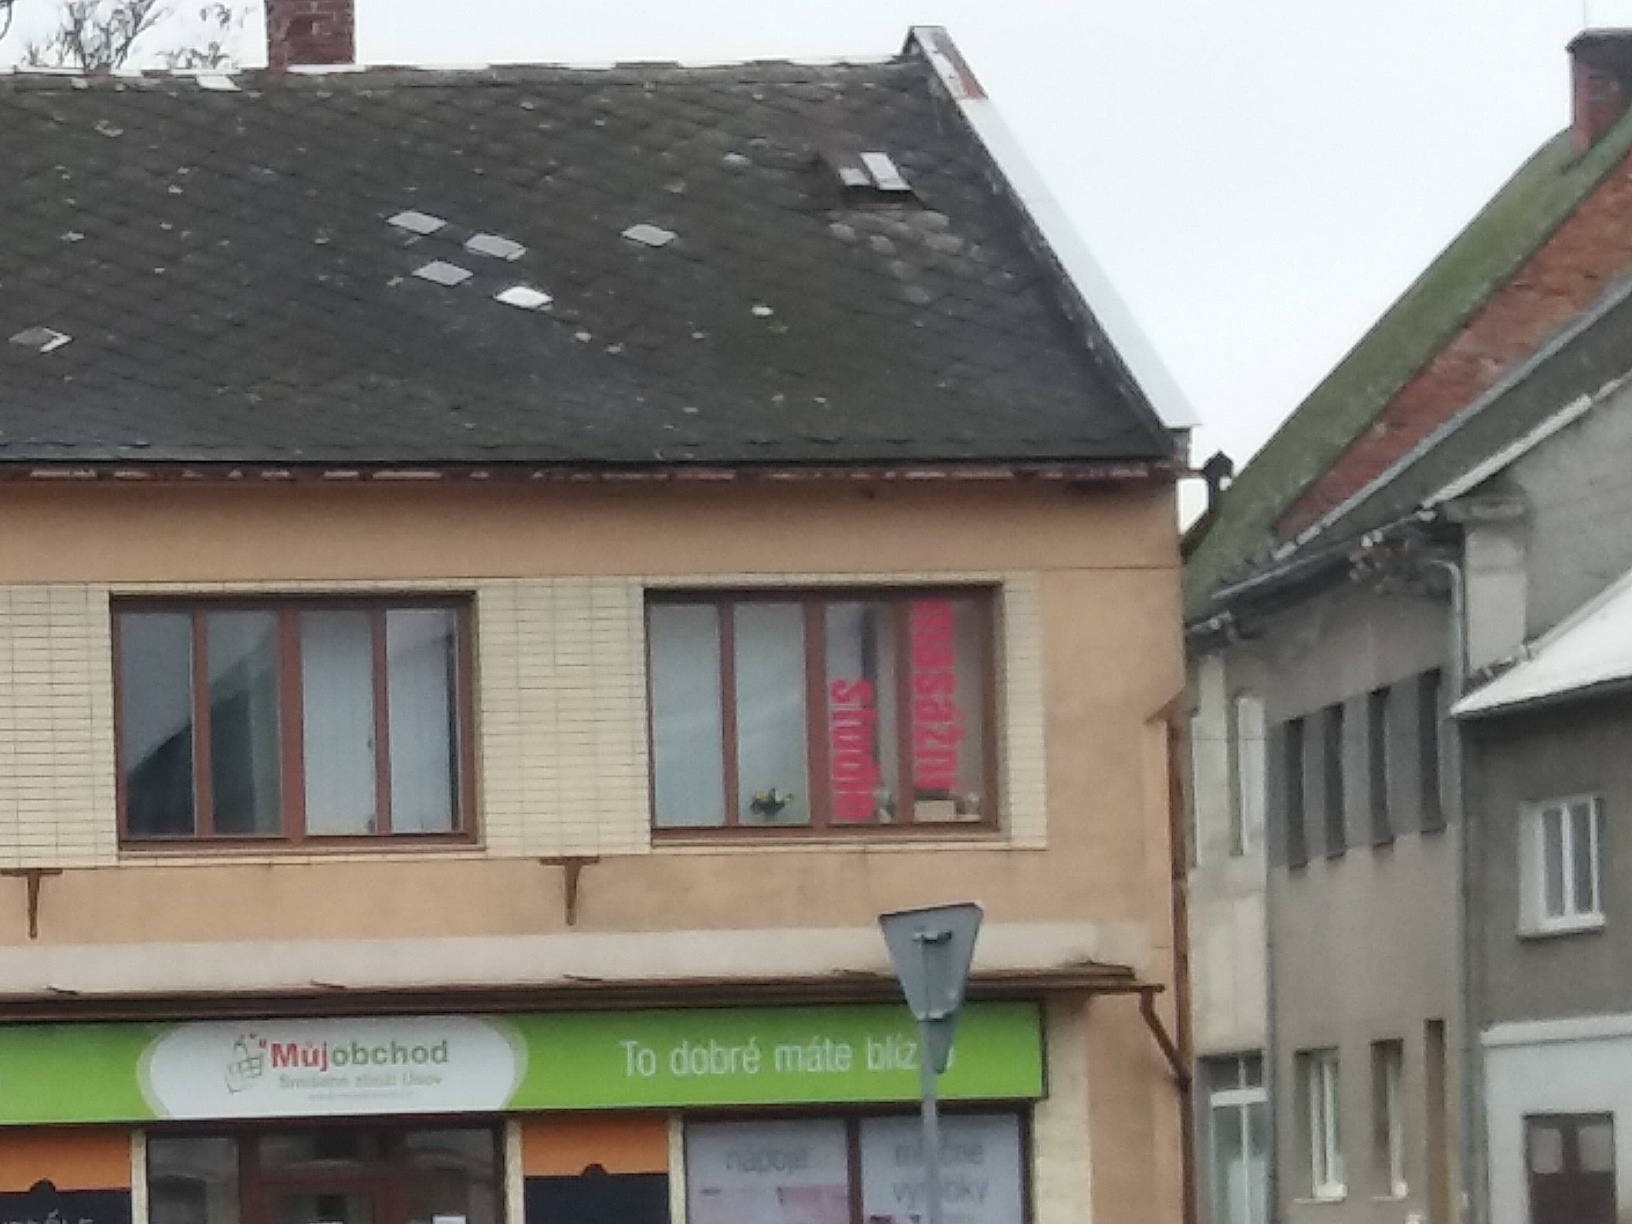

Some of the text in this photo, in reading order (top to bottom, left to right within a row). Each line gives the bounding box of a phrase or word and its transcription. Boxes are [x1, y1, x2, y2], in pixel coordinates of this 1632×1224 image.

[620, 1031, 956, 1077] To dobré máte blíz
